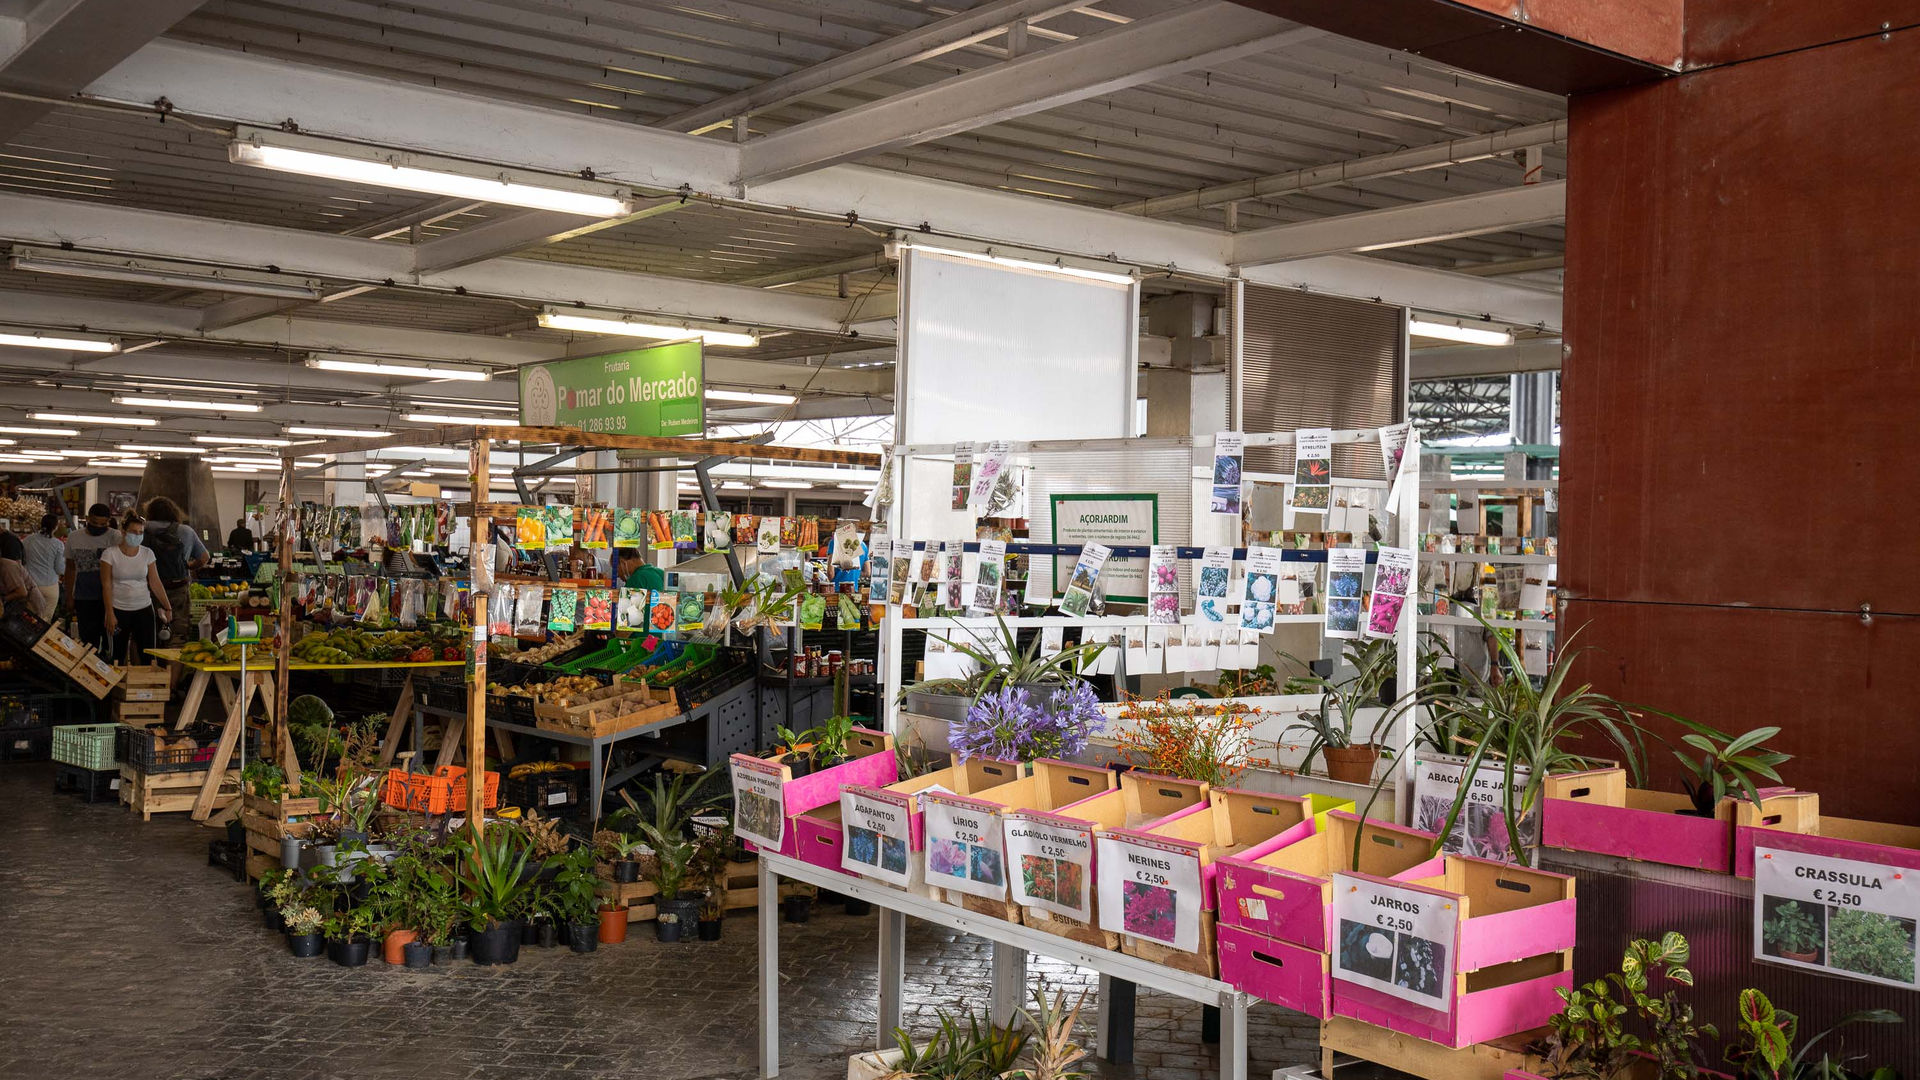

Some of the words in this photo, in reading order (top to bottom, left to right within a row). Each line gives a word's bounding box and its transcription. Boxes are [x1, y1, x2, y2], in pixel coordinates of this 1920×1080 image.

[605, 360, 630, 373] Frutaria
[607, 379, 625, 405] do
[629, 371, 697, 402] Mercado
[589, 418, 603, 432] 286
[605, 416, 615, 430] 93
[616, 415, 627, 430] 93
[1079, 514, 1128, 526] AÇORJARDIM
[757, 777, 780, 790] PINEAPPLE
[1427, 772, 1461, 785] ABACA
[1474, 779, 1489, 788] DE
[1491, 782, 1527, 793] JADI
[1471, 792, 1493, 803] 6,50
[855, 804, 896, 822] AGAPANTOS
[866, 820, 871, 828] €
[872, 821, 886, 832] 2,50
[952, 816, 979, 829] LÍRIOS
[955, 831, 960, 840] €
[962, 833, 978, 843] 2,50
[1011, 829, 1048, 841] GLADÍOLO
[1049, 834, 1087, 848] VERMELHO
[1041, 846, 1047, 854] €
[1128, 853, 1171, 871] NERINES
[1136, 871, 1142, 880] €
[1145, 872, 1165, 884] 2,50
[1795, 866, 1882, 890] CRASSULA
[1370, 895, 1420, 915] JARROS
[1813, 889, 1822, 900] €
[1827, 891, 1861, 906] 2,50
[1376, 914, 1383, 925] €
[1387, 916, 1412, 931] 2,50
